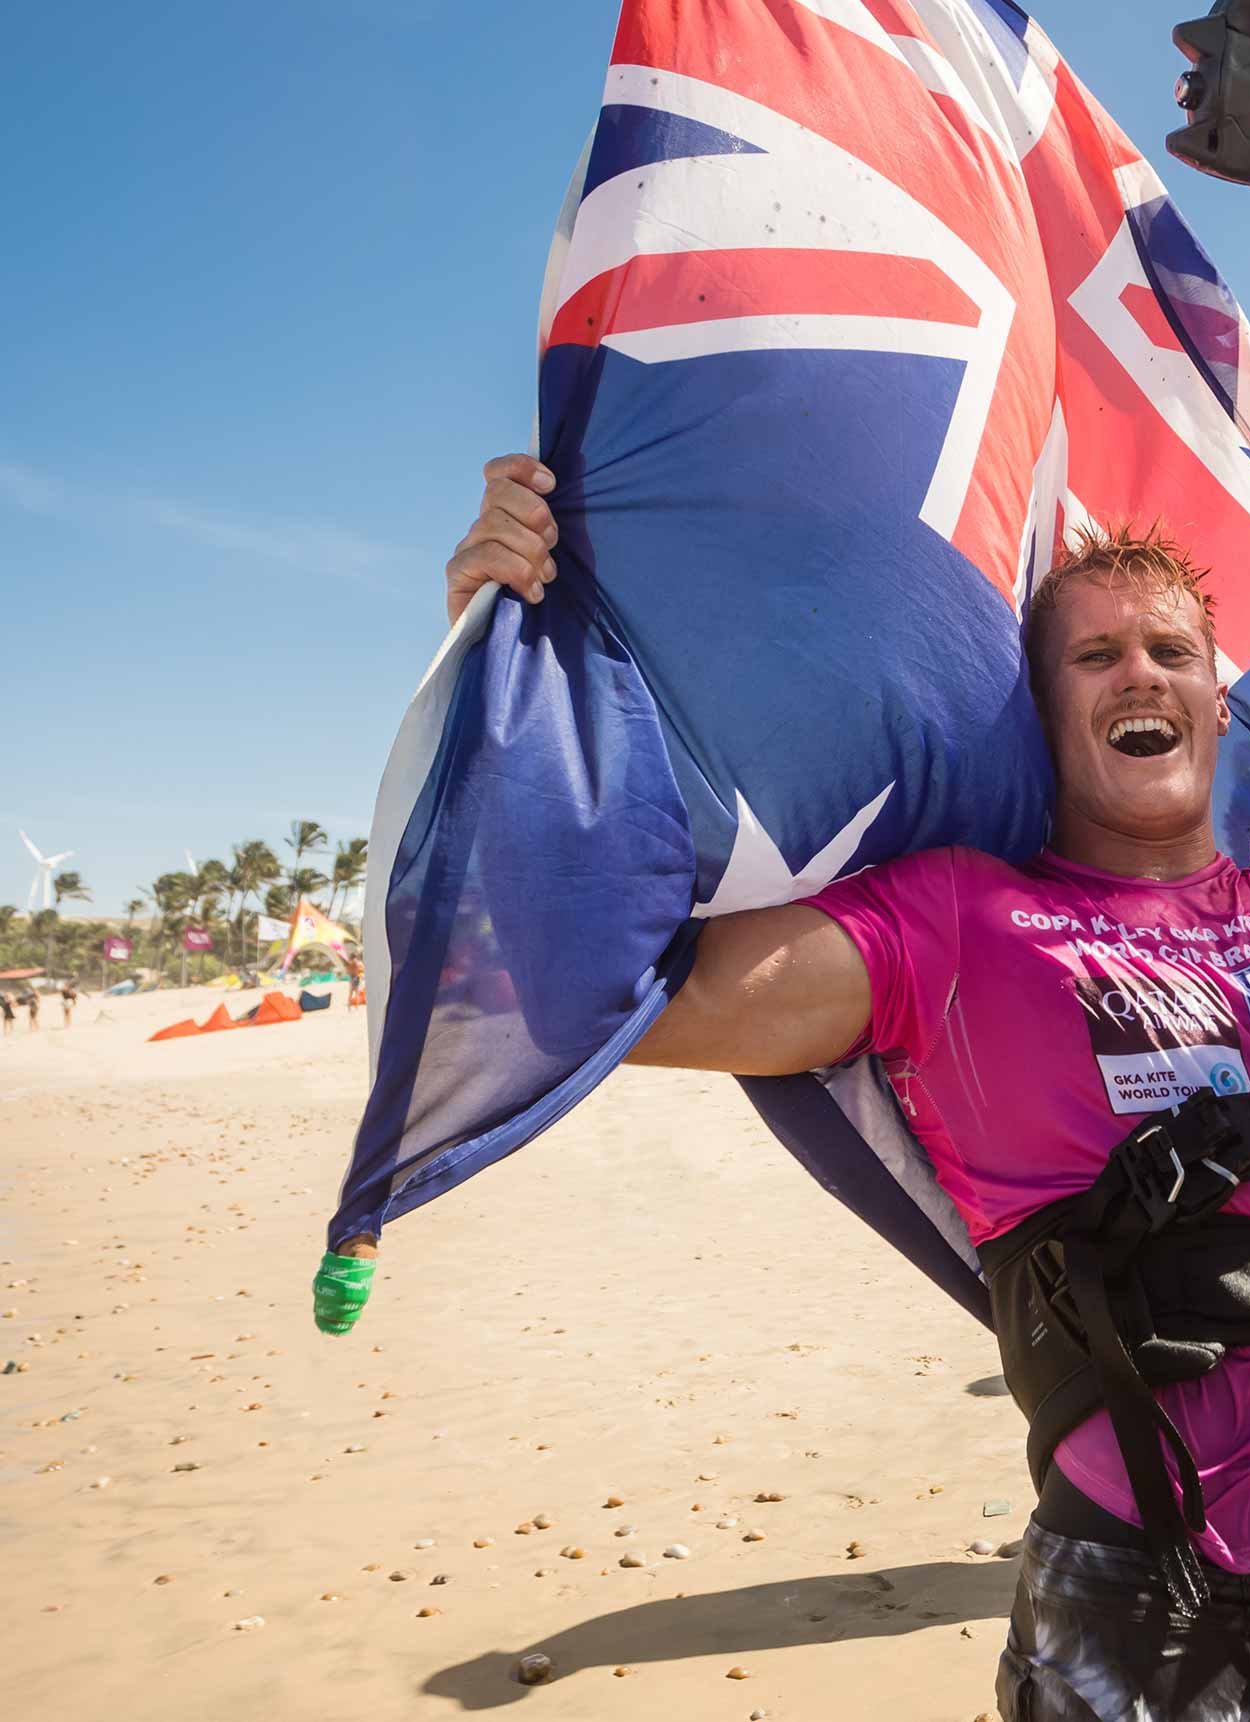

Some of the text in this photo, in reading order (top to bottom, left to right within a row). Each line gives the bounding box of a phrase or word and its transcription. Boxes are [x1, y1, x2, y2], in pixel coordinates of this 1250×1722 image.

[1011, 910, 1087, 932] COPA
[1113, 1071, 1177, 1086] GKA KITE
[1119, 1086, 1201, 1101] WORLD TOU
